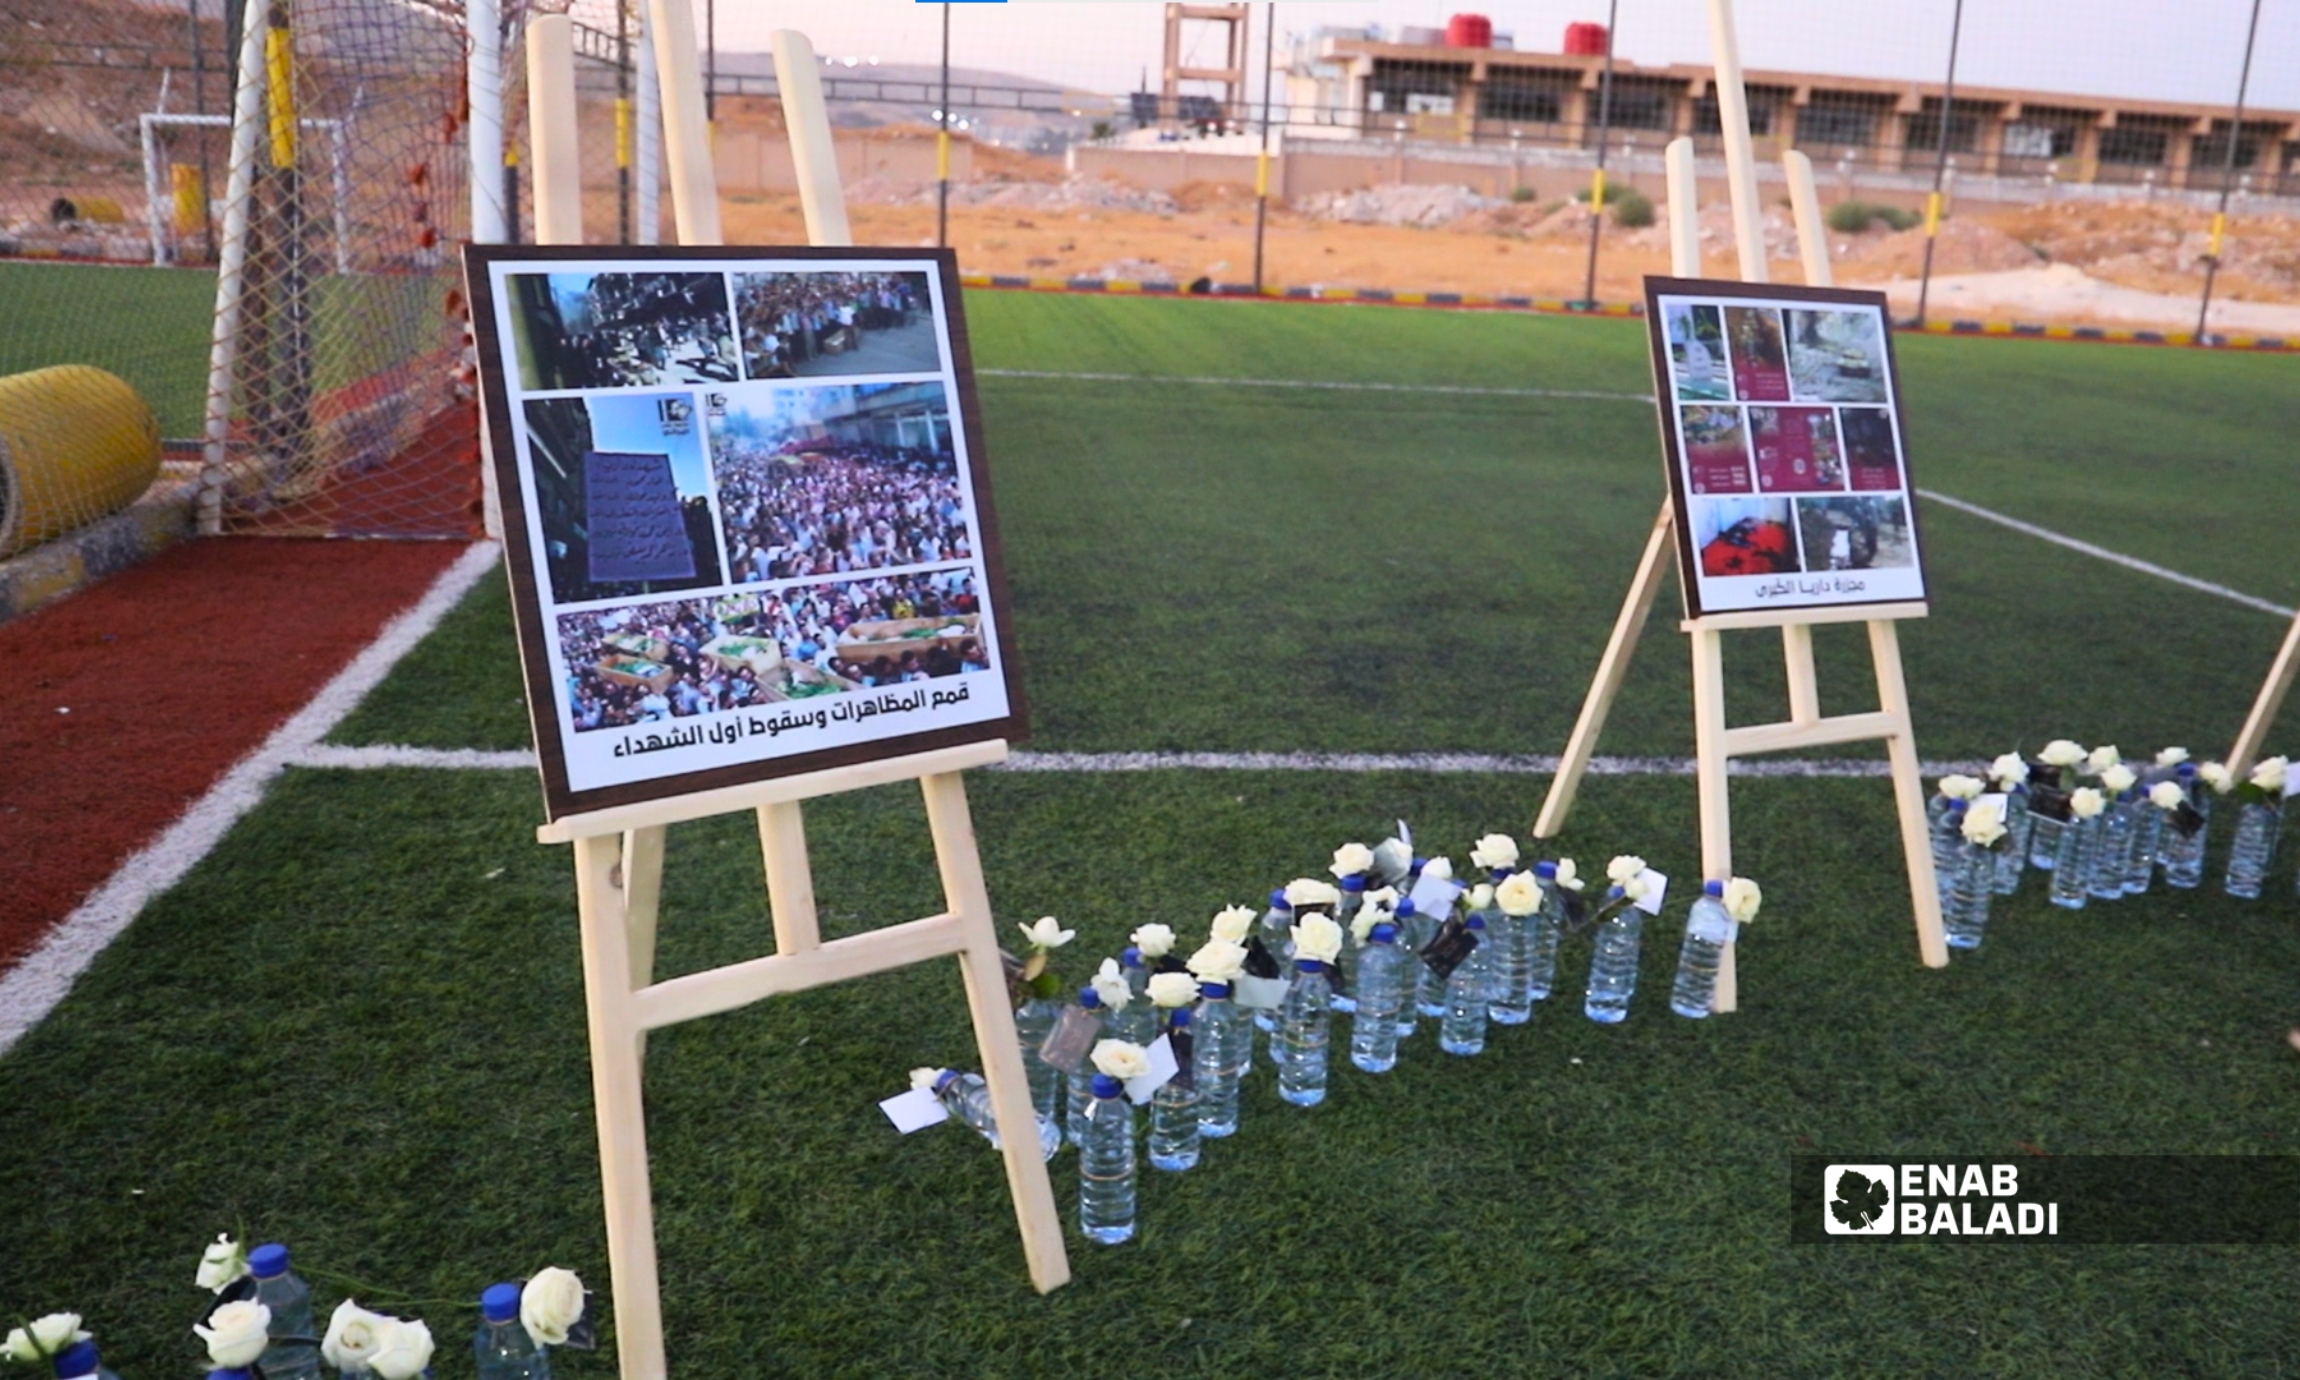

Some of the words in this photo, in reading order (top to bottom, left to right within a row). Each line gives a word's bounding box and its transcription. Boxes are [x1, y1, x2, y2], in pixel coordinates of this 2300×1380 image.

[831, 688, 926, 722] المظاهرات
[931, 681, 969, 710] قمع
[708, 716, 744, 744] أول
[749, 709, 827, 737] وسقوط
[614, 724, 704, 757] الشهداء
